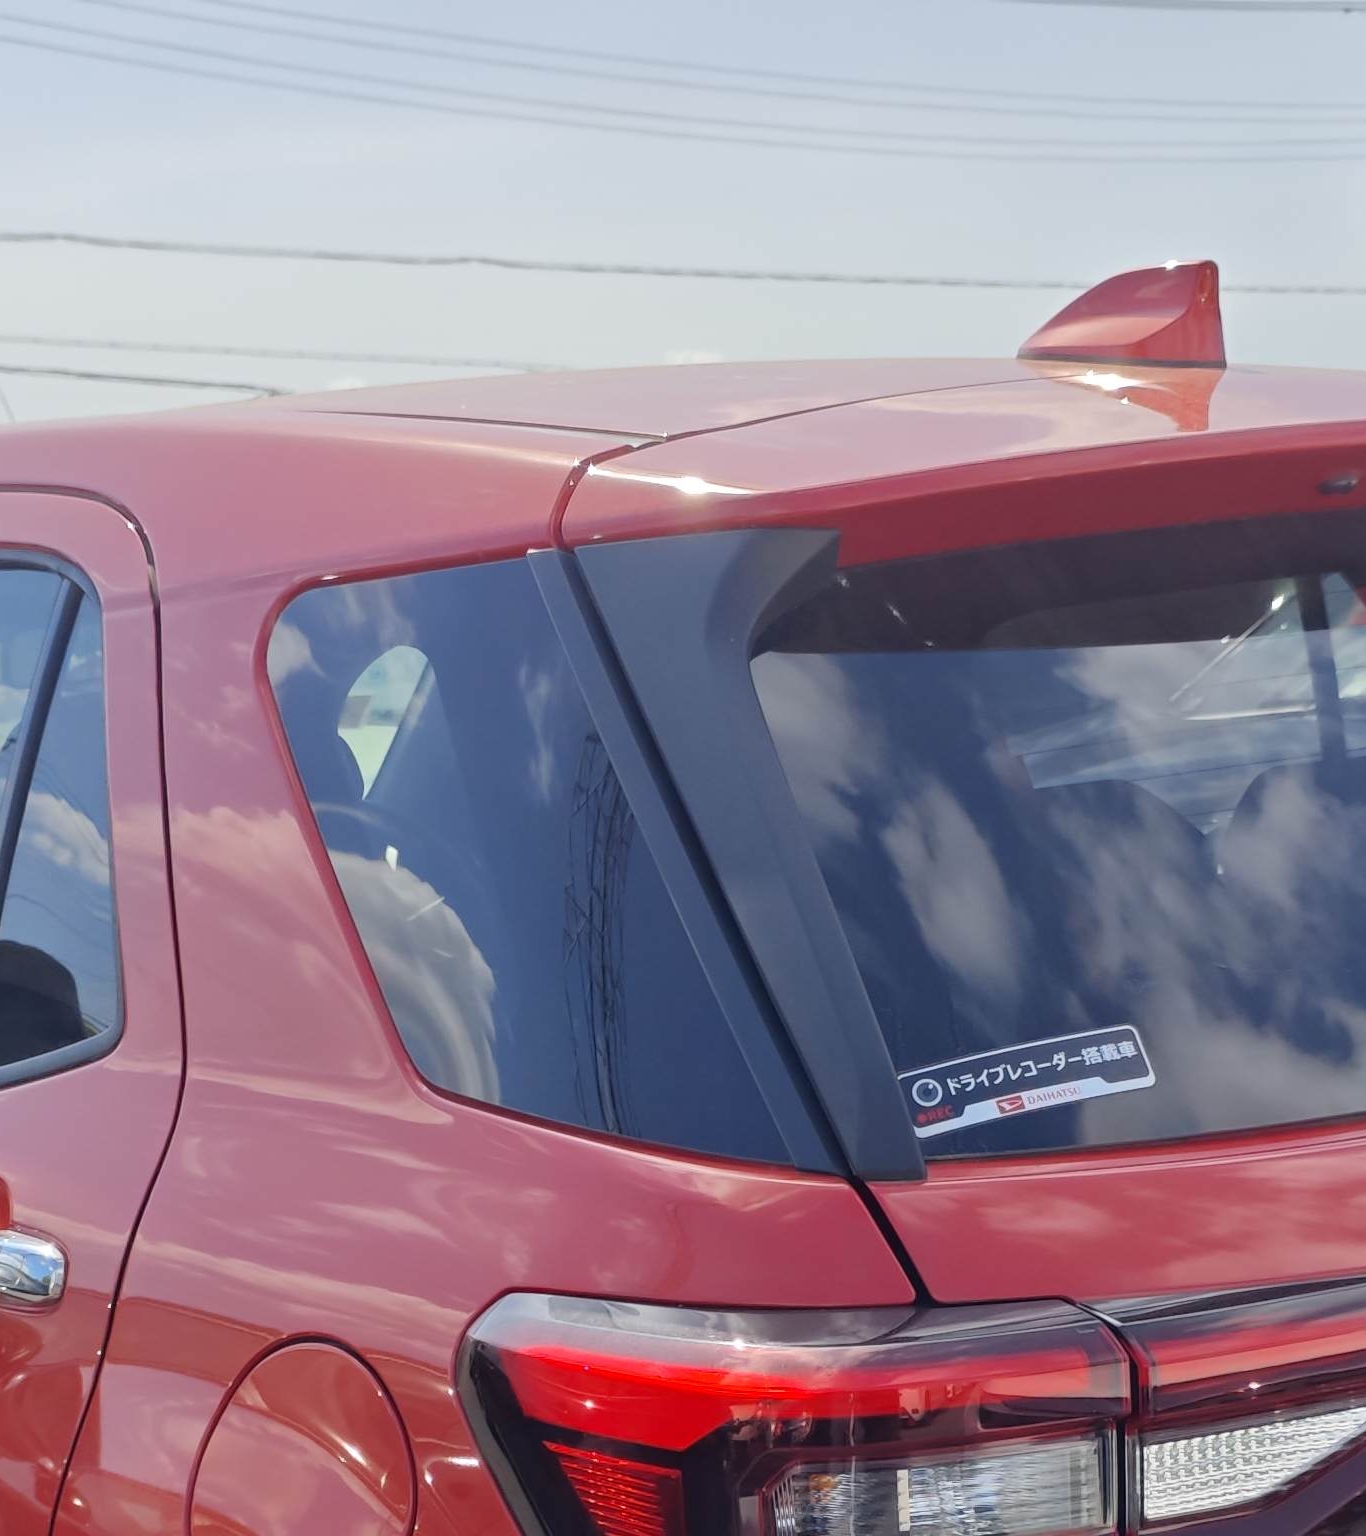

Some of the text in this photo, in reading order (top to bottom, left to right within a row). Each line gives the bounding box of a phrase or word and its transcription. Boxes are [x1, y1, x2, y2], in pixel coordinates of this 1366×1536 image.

[946, 1040, 1138, 1095] ドライブレコーダー搭載車
[1026, 1086, 1080, 1106] DAIHATSU
